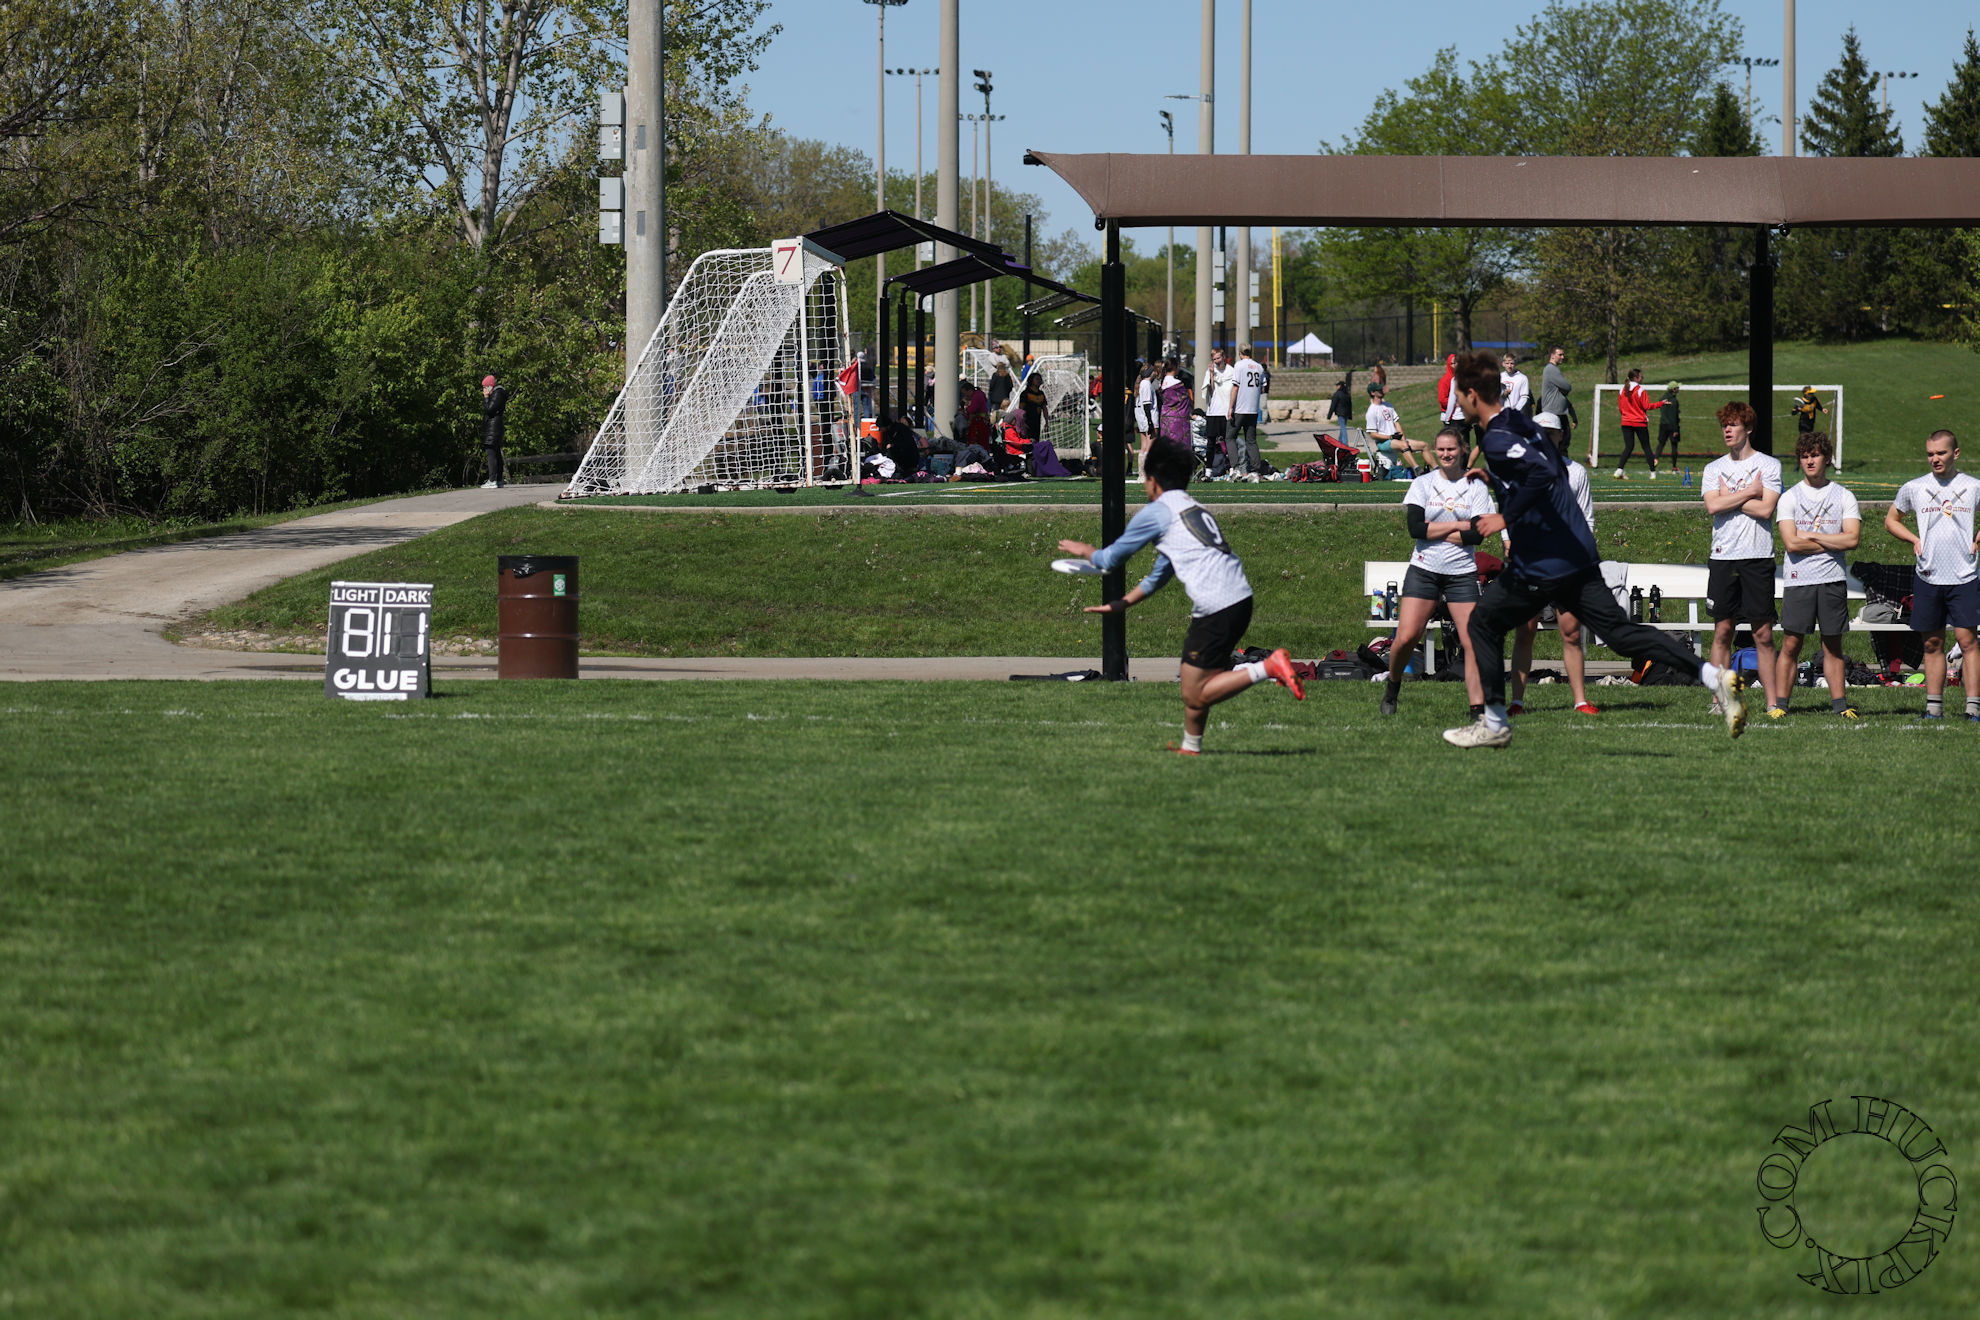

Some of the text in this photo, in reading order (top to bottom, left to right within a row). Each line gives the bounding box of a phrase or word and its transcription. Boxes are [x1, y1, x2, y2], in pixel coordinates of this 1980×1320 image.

[777, 246, 798, 275] 7
[1247, 371, 1260, 388] 26
[1921, 506, 1941, 514] CALVIN
[1200, 512, 1222, 544] 9
[333, 588, 428, 603] LIGHT DARK
[342, 608, 374, 657] 8
[333, 668, 418, 690] GLUE
